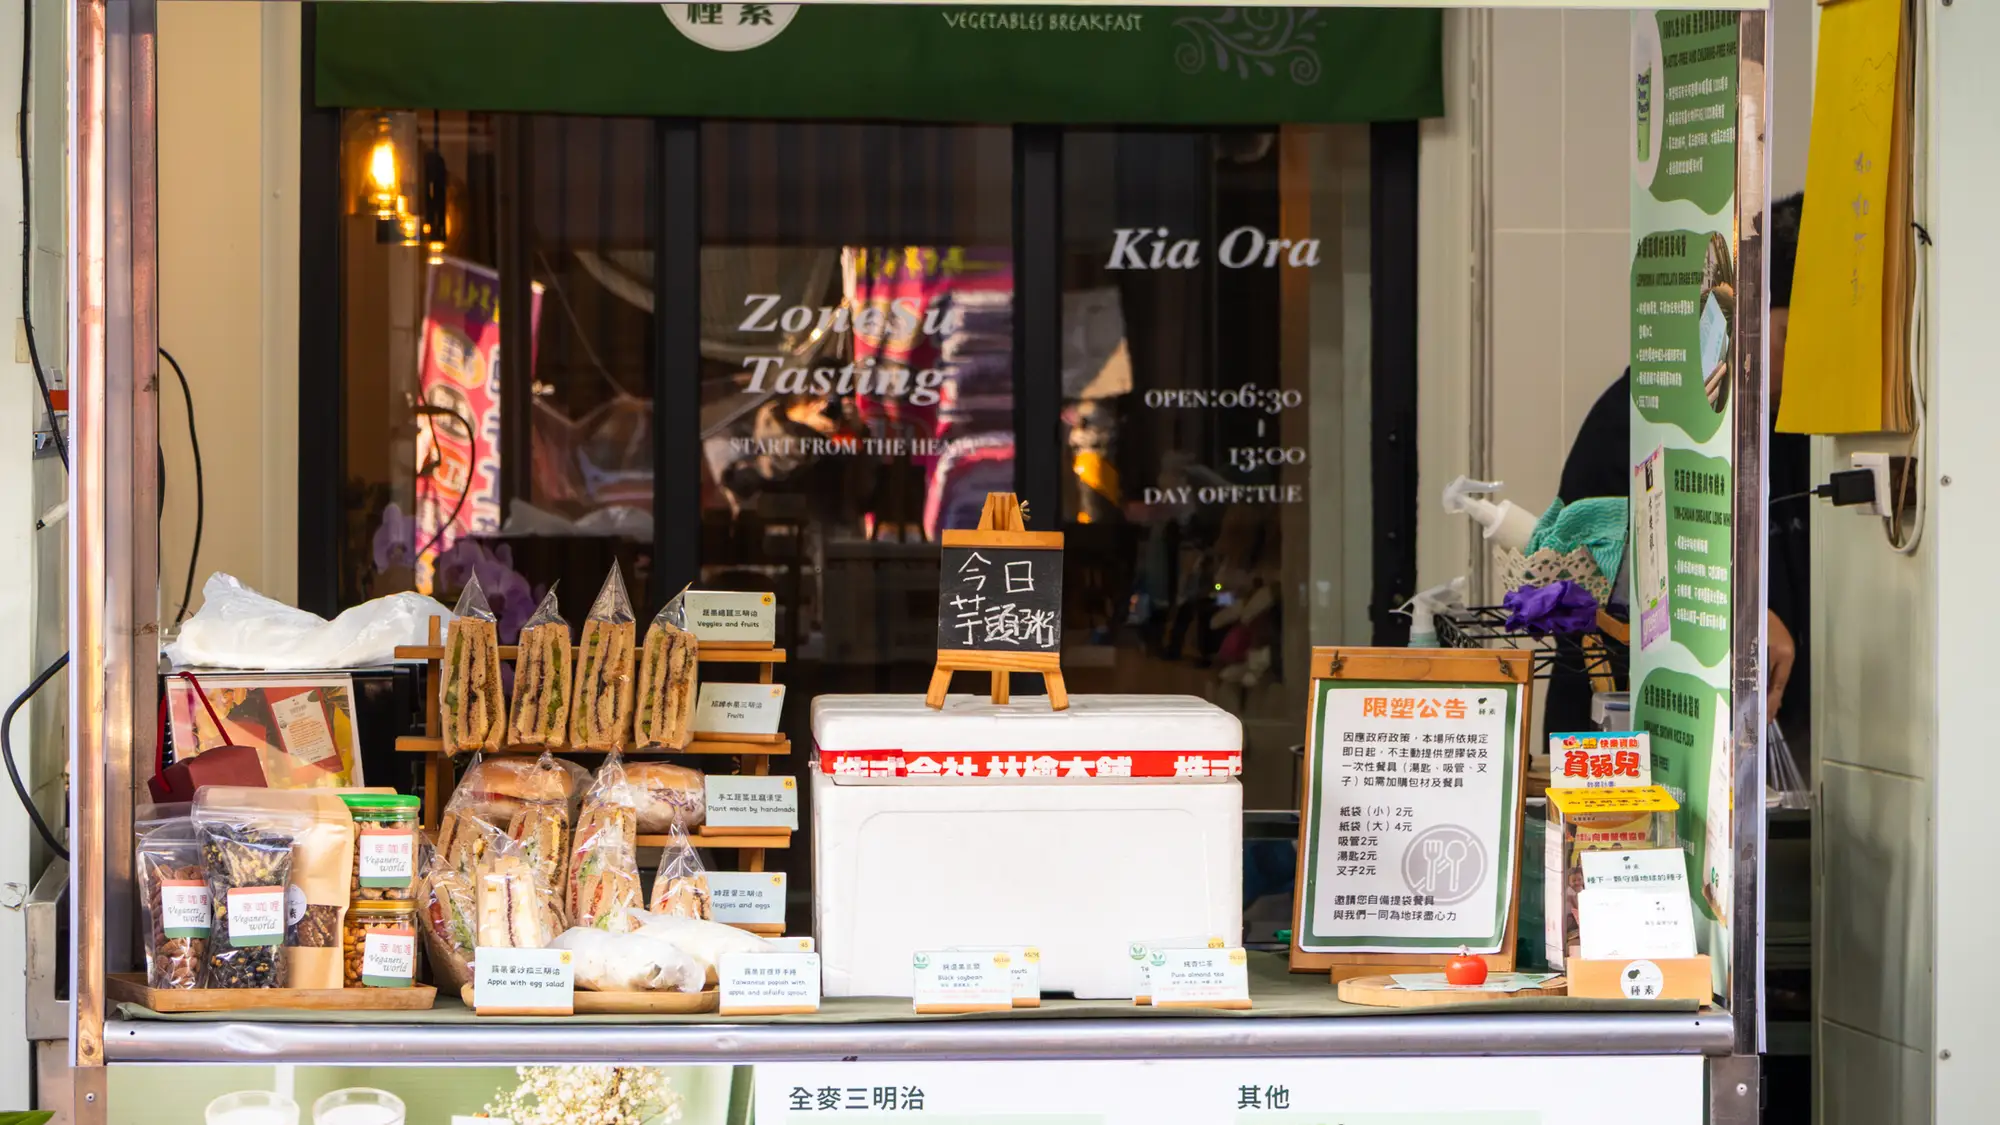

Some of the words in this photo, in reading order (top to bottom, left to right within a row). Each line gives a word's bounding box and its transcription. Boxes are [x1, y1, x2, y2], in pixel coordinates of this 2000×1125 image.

[942, 12, 1042, 30] VEGETABLES
[1049, 12, 1144, 31] BREAKFAST
[1105, 226, 1200, 270] Kia
[1218, 226, 1321, 269] Ora
[739, 294, 957, 334] ZoneSu
[741, 355, 949, 406] Tasting
[1144, 384, 1302, 415] OPEN:06:30
[730, 437, 794, 456] START
[801, 437, 857, 456] FROM
[864, 437, 906, 456] THE
[1229, 446, 1306, 470] 13:00
[1144, 486, 1191, 505] DAY
[1198, 485, 1301, 504] OFF:TUE
[958, 552, 1034, 593] 今日
[697, 620, 723, 628] Veggies
[741, 620, 760, 628] fruits
[949, 594, 1056, 649] 芋頭粥
[1362, 696, 1468, 720] 限塑公告
[1343, 732, 1489, 744] 因應政府政策，本場所依規定
[1342, 746, 1488, 759] 即日起，不主動提供塑膠袋及
[1563, 750, 1640, 778] 貧弱兒
[749, 805, 758, 814] by
[1339, 805, 1413, 817] 紙袋（小）2元
[1338, 820, 1412, 832] 紙袋（大）4元
[1337, 836, 1378, 846] 吸管2元
[1337, 851, 1377, 861] 湯匙2元
[379, 861, 407, 872] world
[1336, 865, 1376, 876] 叉子2元
[755, 902, 771, 910] eggs
[1334, 894, 1435, 906] 邀請您自備提袋餐具
[182, 912, 206, 923] world
[1333, 909, 1457, 921] 與我們一同為地球盡心力
[248, 919, 278, 930] world
[383, 962, 408, 973] world
[487, 979, 507, 987] Apple
[788, 1085, 926, 1112] 全麥三明治
[1237, 1084, 1291, 1110] 其他
